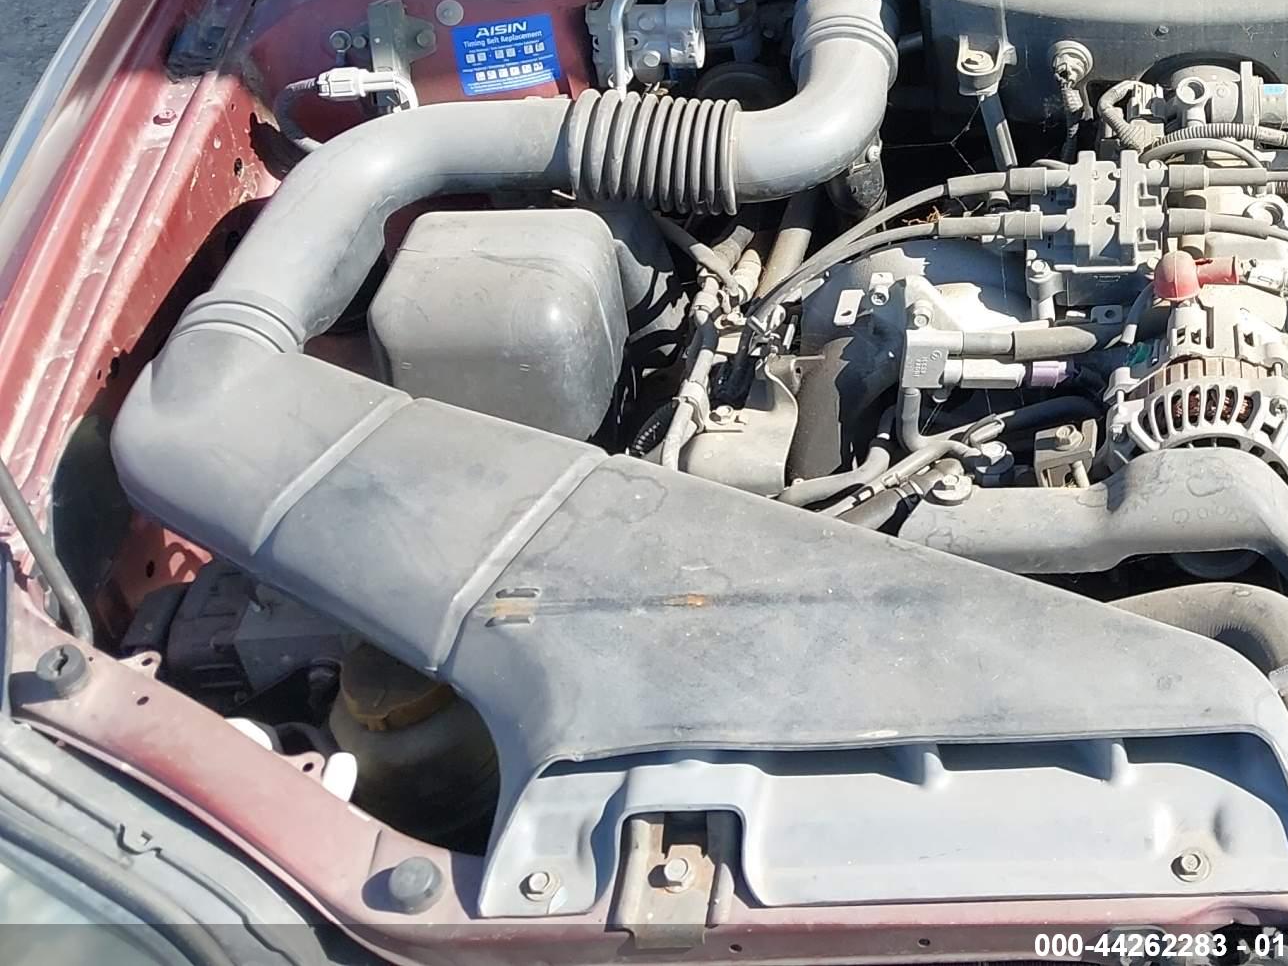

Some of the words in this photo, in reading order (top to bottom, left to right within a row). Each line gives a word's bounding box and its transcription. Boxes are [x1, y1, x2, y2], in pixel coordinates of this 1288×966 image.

[476, 22, 527, 38] AISIN
[463, 39, 486, 49] Timing
[486, 36, 500, 45] Belt
[500, 30, 543, 44] Replacement
